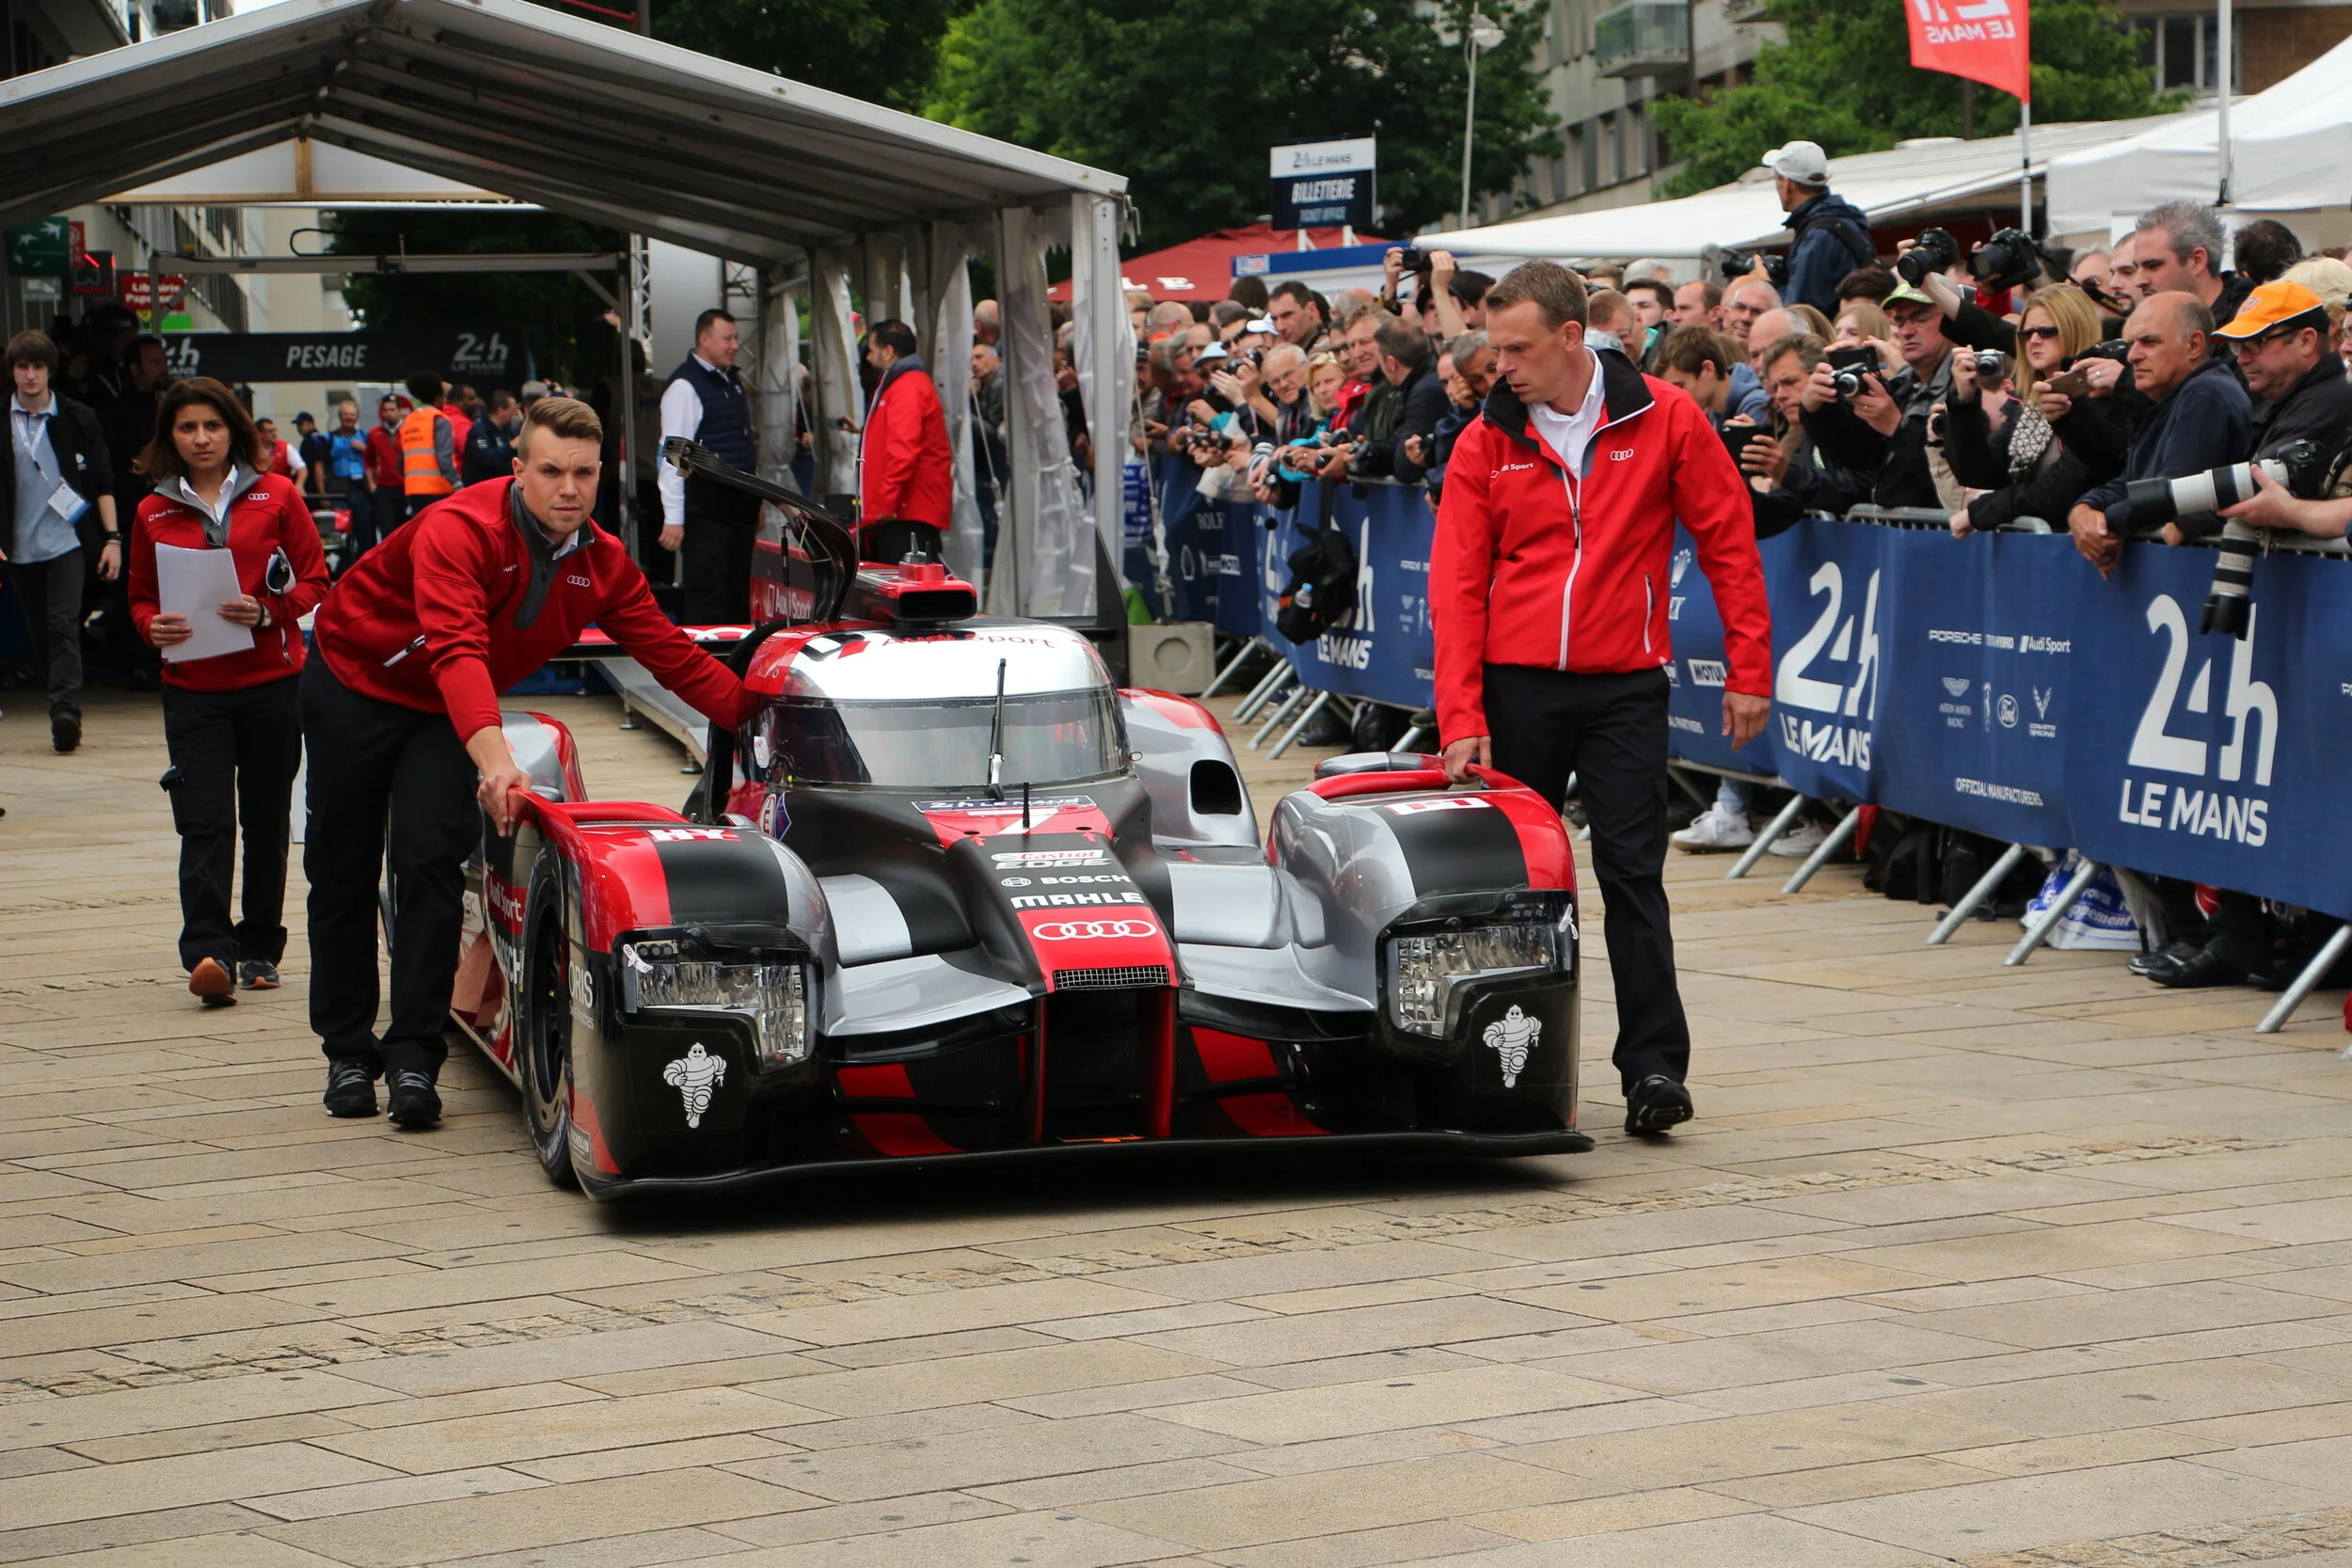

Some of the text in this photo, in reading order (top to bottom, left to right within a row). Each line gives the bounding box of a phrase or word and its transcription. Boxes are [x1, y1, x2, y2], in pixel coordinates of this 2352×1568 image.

[285, 345, 368, 369] PESAGE
[455, 331, 509, 363] 24h
[1510, 462, 1534, 471] Sport
[791, 591, 812, 620] Sport
[963, 632, 1056, 649] Sport
[1318, 633, 1374, 671] LE MANS
[1775, 562, 1881, 721] 24h
[1930, 629, 1982, 645] PORSCHE
[2028, 636, 2045, 651] Audi
[2045, 637, 2072, 655] Sport
[2128, 594, 2279, 787] 24h
[1779, 711, 1872, 772] LE MANS
[1955, 777, 2043, 807] OFFICIAL MANUFACTURERS
[2120, 778, 2269, 847] LE MANS
[994, 858, 1113, 871] EDGE
[1019, 849, 1095, 861] Castrol
[1040, 874, 1132, 885] BOSCH
[500, 885, 523, 922] Sport
[1009, 891, 1145, 910] MAHLE
[568, 960, 594, 1008] ORIS
